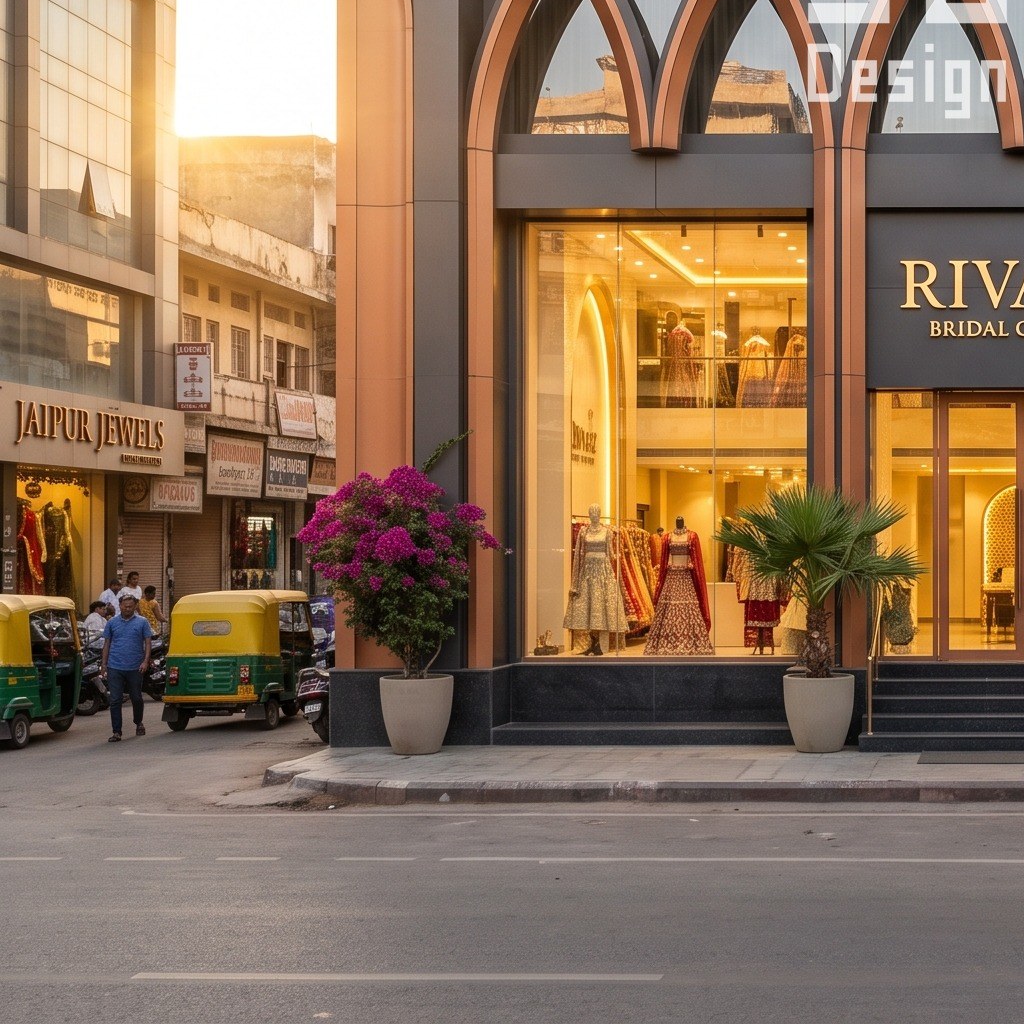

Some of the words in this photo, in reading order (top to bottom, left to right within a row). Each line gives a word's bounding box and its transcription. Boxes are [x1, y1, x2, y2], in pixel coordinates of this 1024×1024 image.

[930, 320, 1009, 337] BRIDAL
[16, 399, 93, 444] JAIPUR
[95, 411, 165, 451] JEWELS
